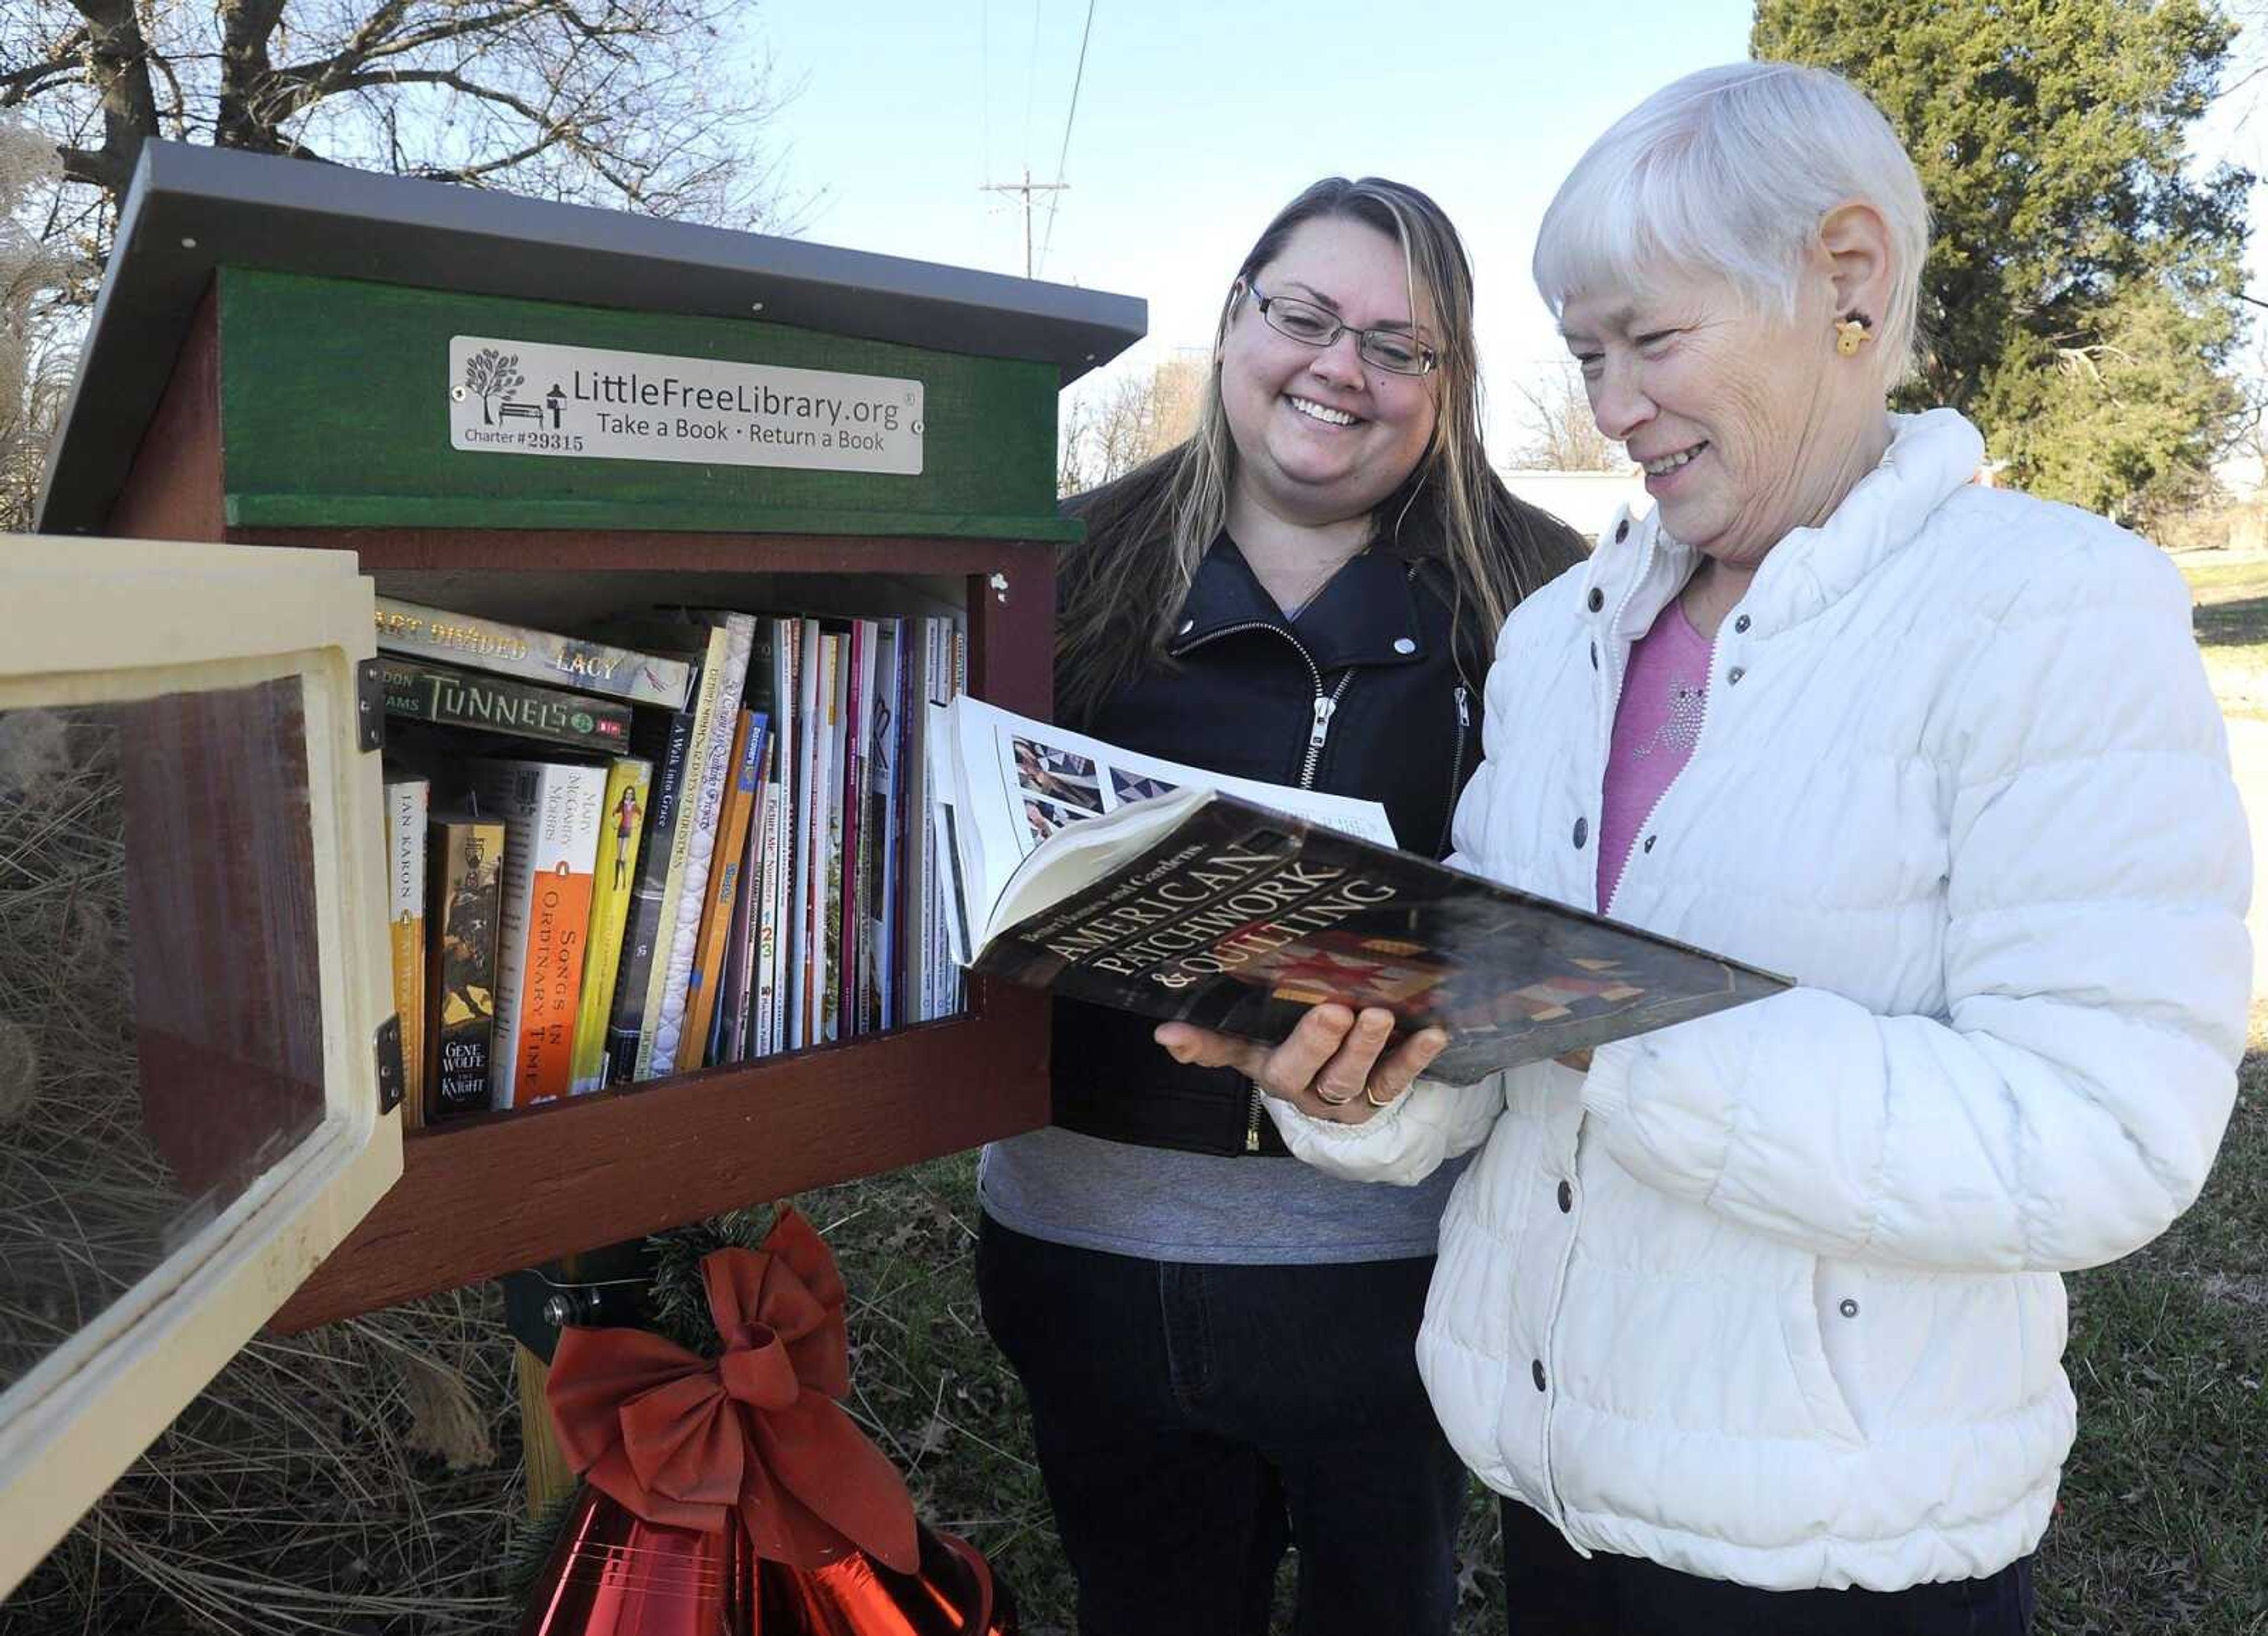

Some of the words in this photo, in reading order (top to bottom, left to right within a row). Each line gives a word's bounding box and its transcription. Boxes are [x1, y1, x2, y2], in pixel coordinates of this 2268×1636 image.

[575, 370, 899, 431] LittleFreeLibrary.org
[465, 429, 513, 444] Charter
[597, 412, 650, 436] Take
[657, 421, 669, 436] a
[676, 418, 728, 441] Book
[750, 423, 816, 447] Return
[822, 433, 833, 447] a
[838, 431, 885, 452] Book
[556, 650, 625, 680] LACY
[423, 674, 568, 733] TUNNELS
[674, 724, 686, 734] A
[669, 738, 685, 765] Walk
[664, 769, 677, 791] into
[401, 794, 412, 827] JAN
[659, 794, 673, 827] Grace
[768, 799, 778, 832] Picture
[400, 836, 412, 898] KARON
[764, 861, 775, 904] Numbers
[1047, 843, 1282, 962] AMERICAN
[1093, 862, 1345, 976] PATCHWORK
[1152, 972, 1197, 989] &
[1179, 879, 1396, 973] QUILTING
[533, 891, 559, 1016] ORDINARY
[553, 930, 576, 1011] SONGS
[443, 1055, 485, 1073] WOLFE
[446, 1041, 482, 1058] GENE
[442, 1078, 484, 1100] KNIGHT
